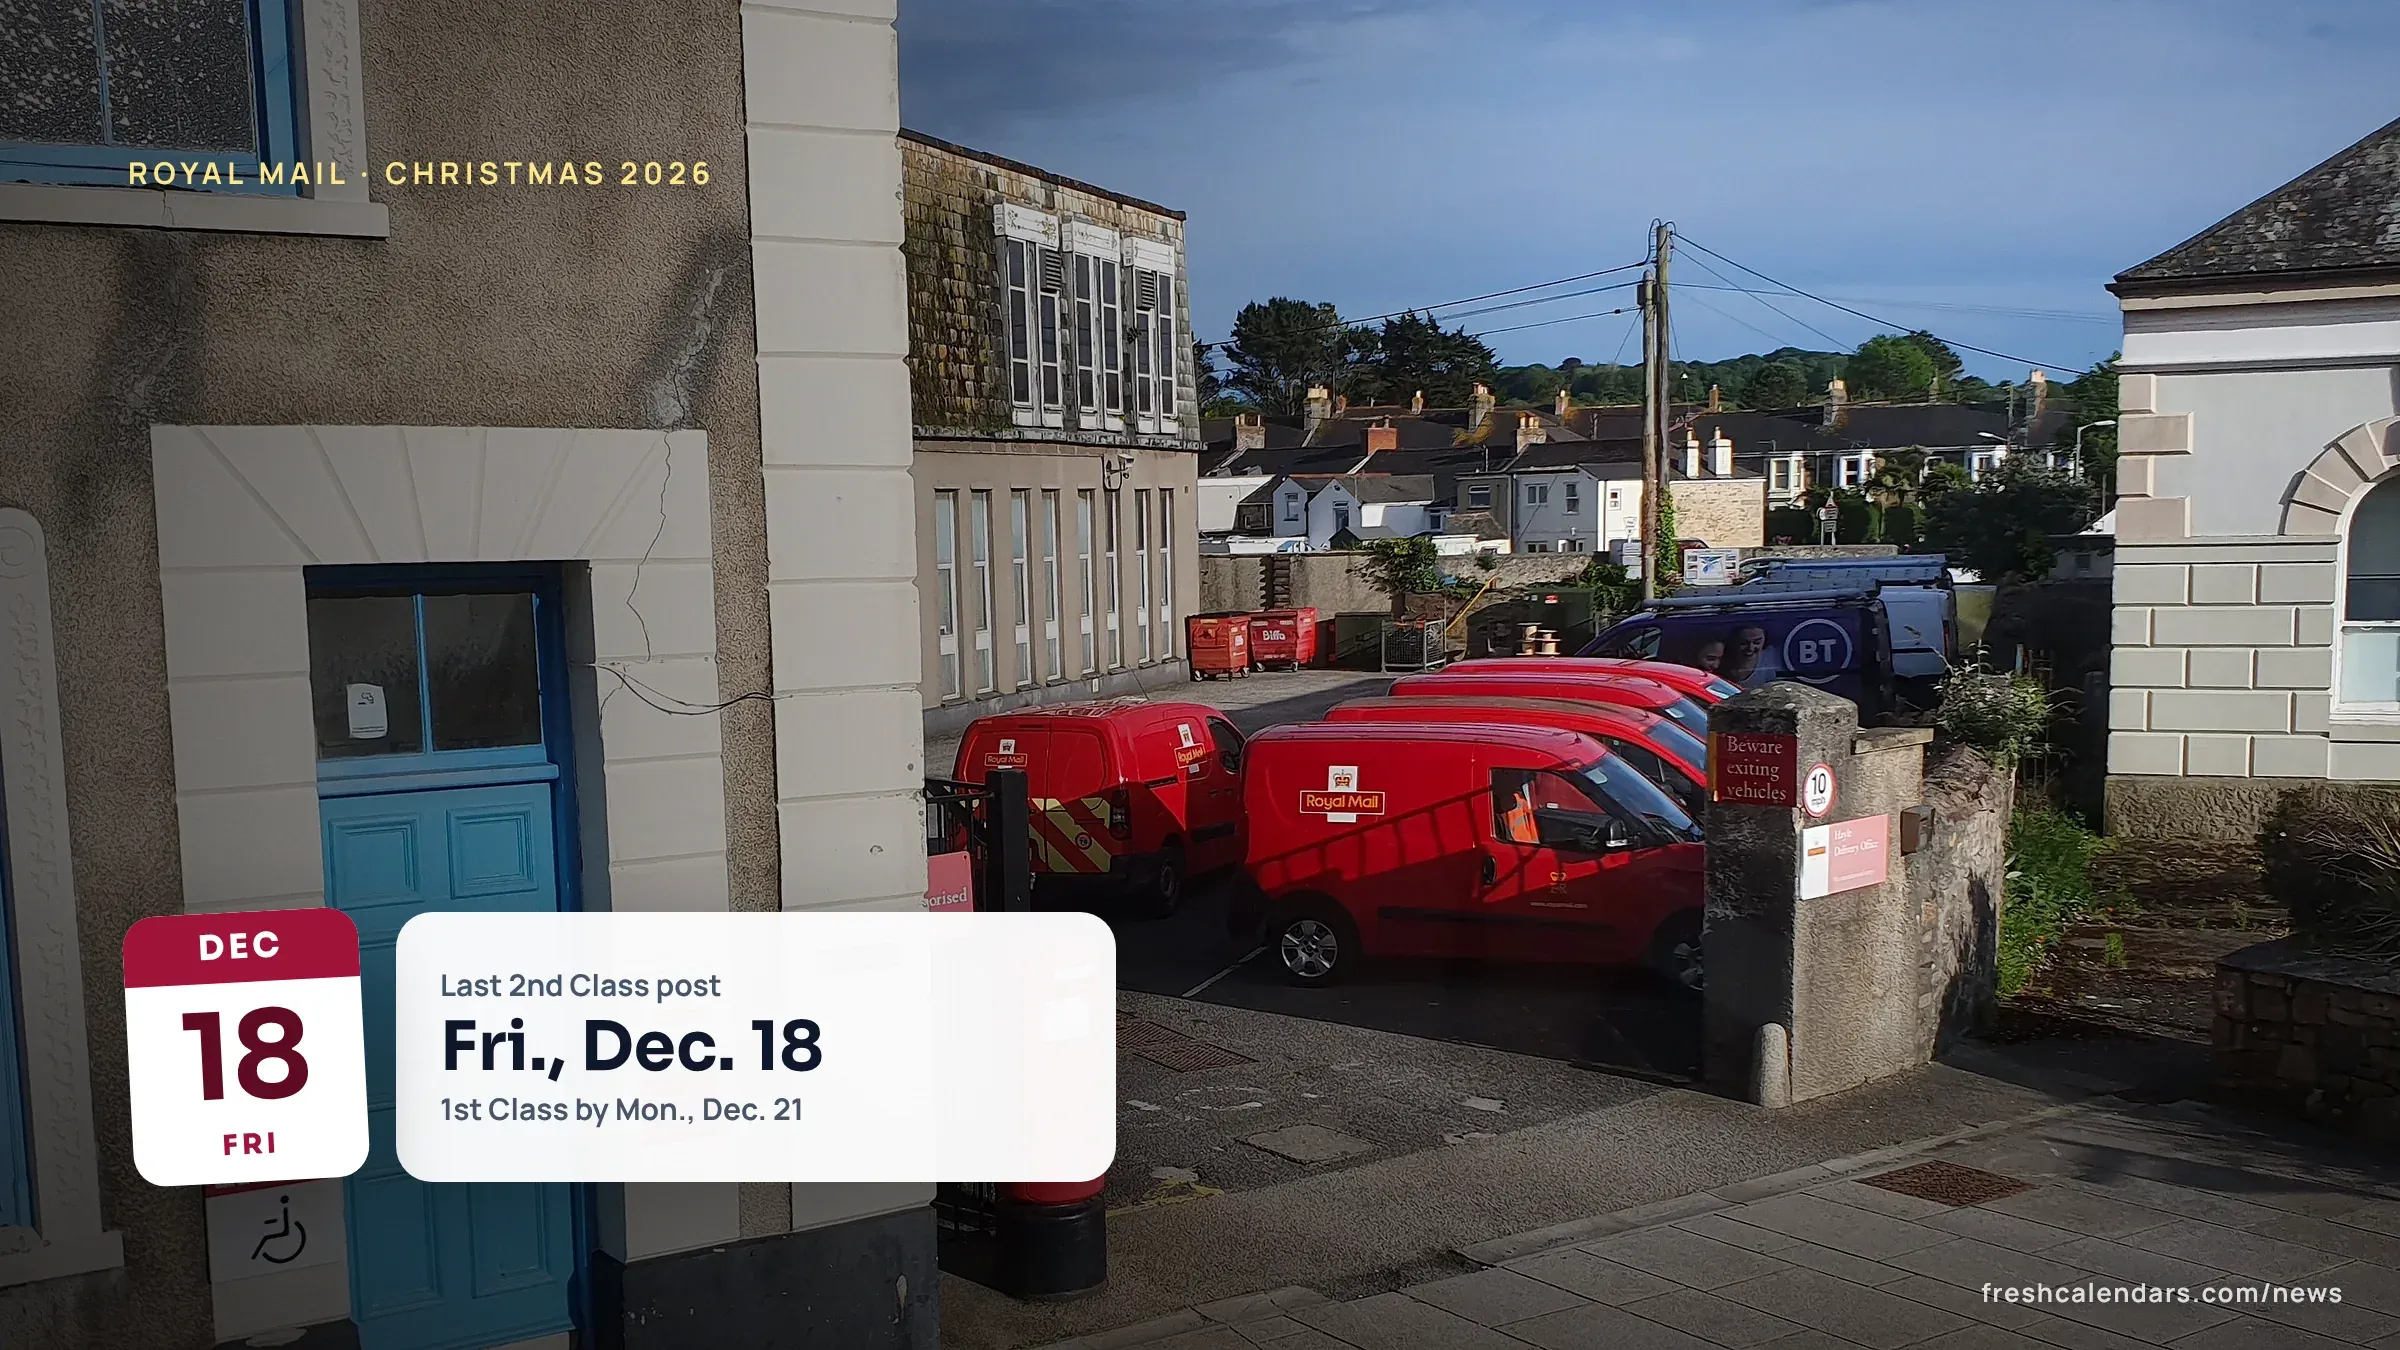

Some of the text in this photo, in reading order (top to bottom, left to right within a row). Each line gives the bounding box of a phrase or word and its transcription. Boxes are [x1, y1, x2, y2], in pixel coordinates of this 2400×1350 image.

[1262, 630, 1286, 641] Biffa
[1799, 639, 1836, 664] BT
[1727, 735, 1783, 755] Beware
[987, 755, 1025, 764] Royal Mail
[1727, 758, 1780, 782] exiting
[1727, 781, 1787, 800] vehicles
[1811, 773, 1827, 795] 10
[1306, 794, 1379, 810] Royal Mail
[929, 886, 967, 907] orised
